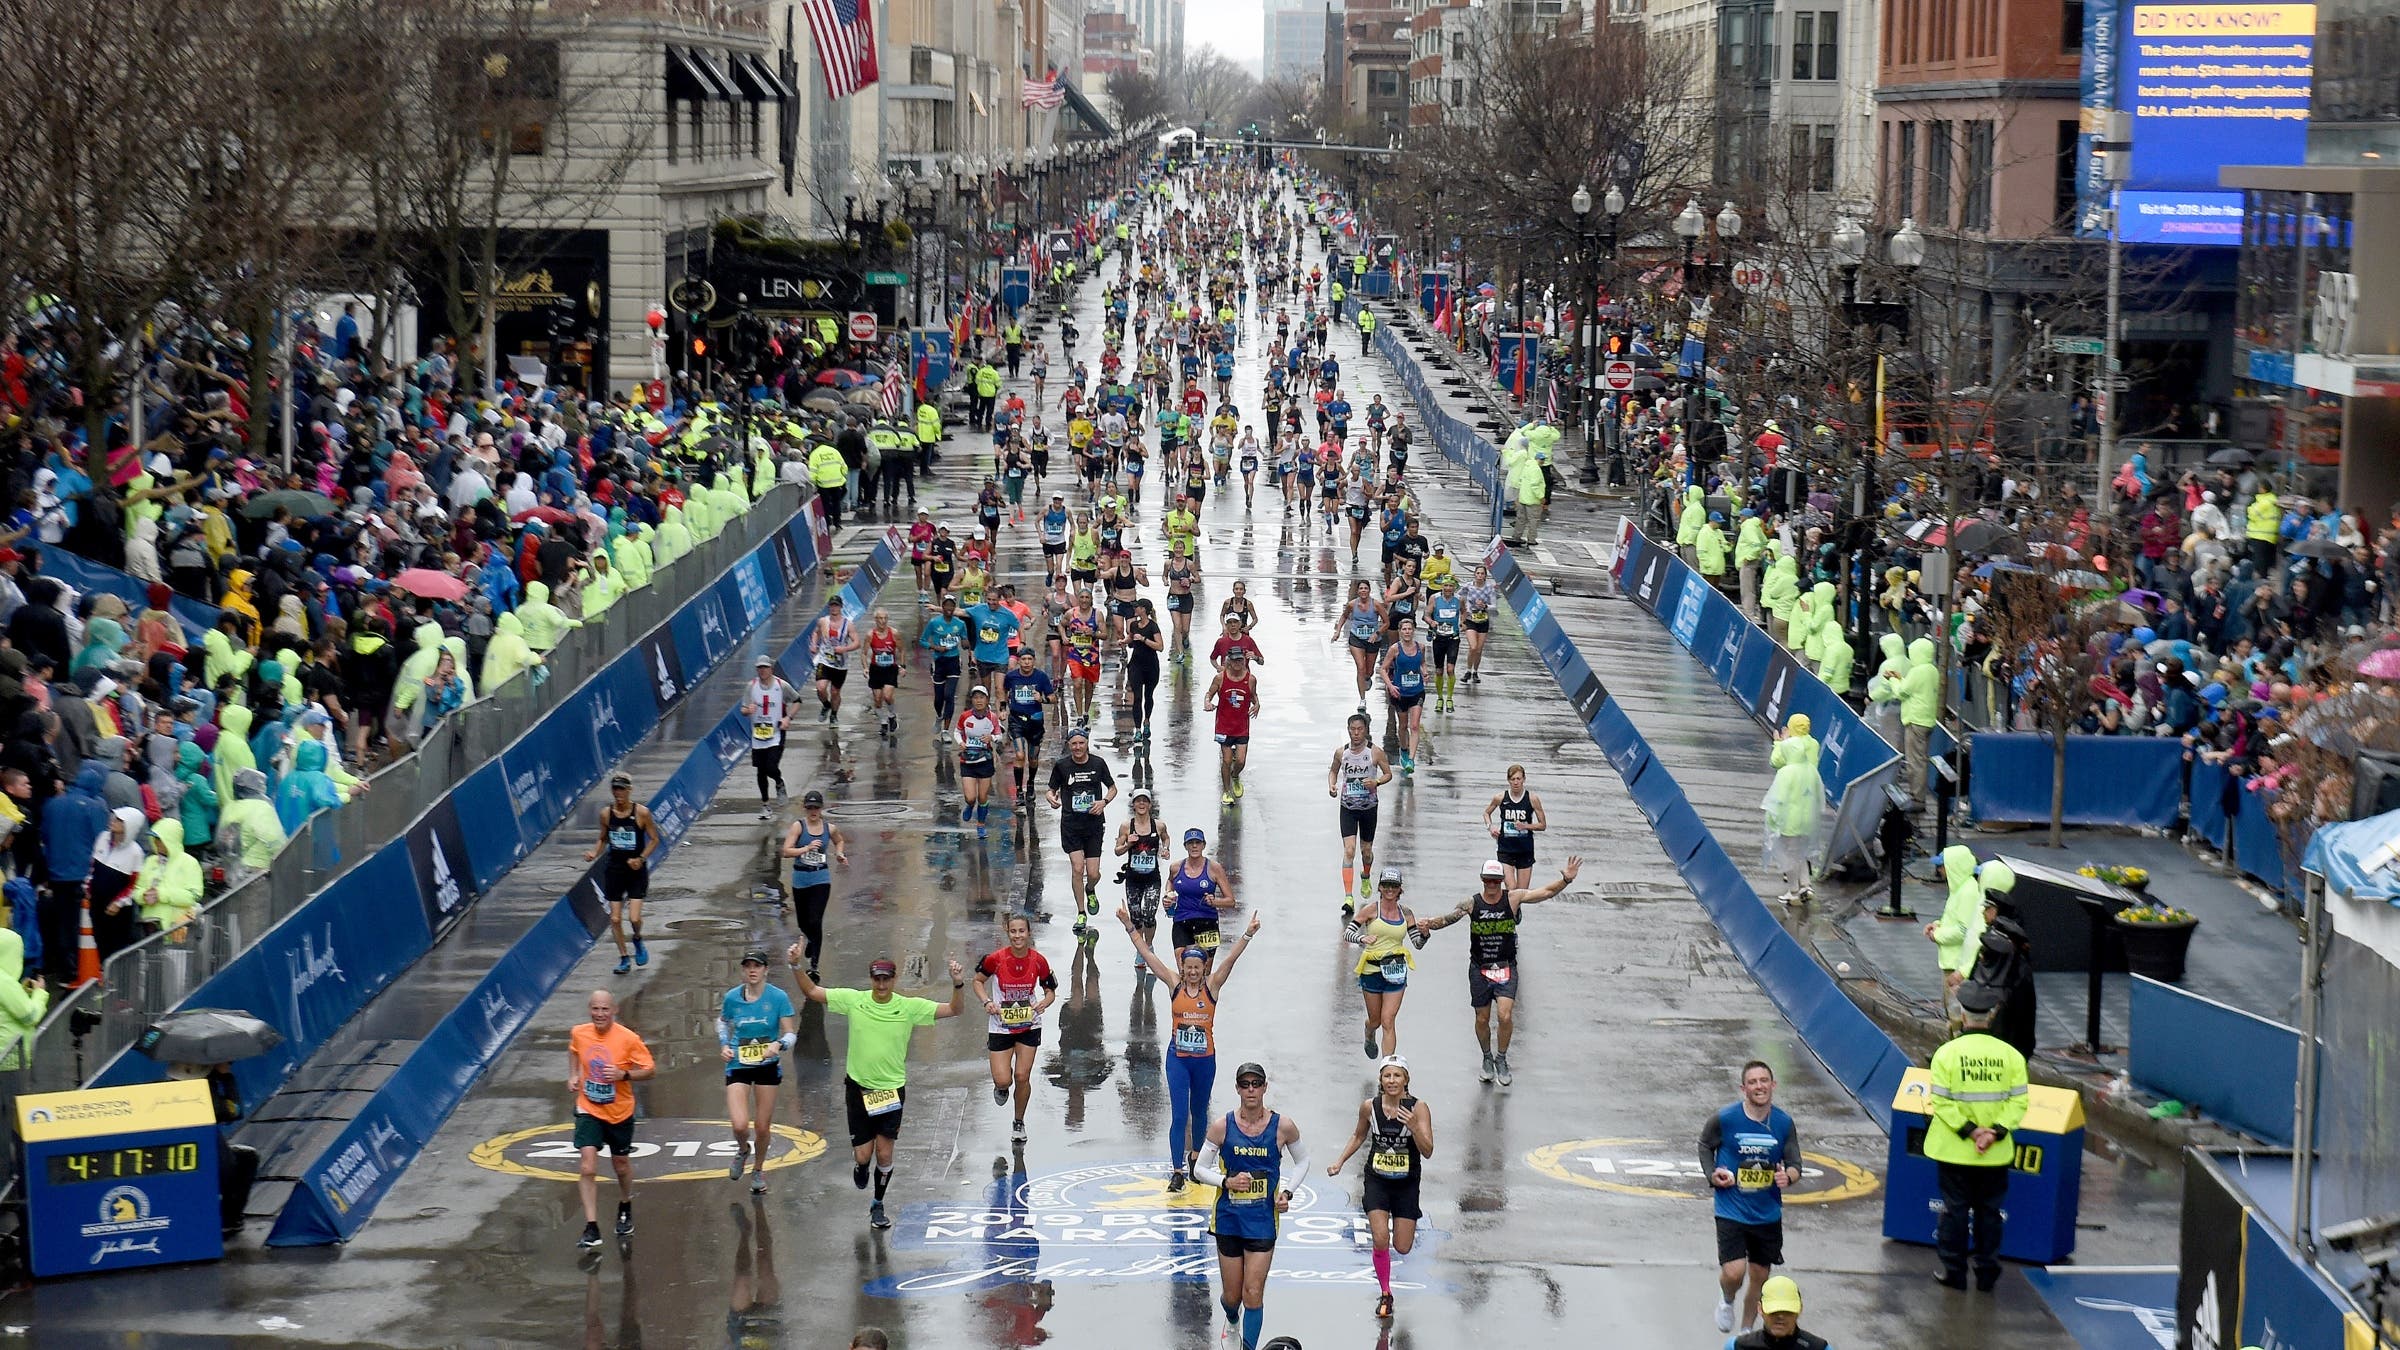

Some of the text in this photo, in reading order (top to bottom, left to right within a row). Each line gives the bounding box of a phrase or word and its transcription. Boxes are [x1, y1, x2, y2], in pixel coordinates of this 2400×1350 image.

[2137, 12, 2281, 28] DID YOU KNOW?
[2094, 16, 2110, 96] MARATHON
[2088, 156, 2103, 190] 2019
[761, 277, 834, 299] LENOX
[1505, 809, 1527, 820] RATS
[1180, 1031, 1205, 1043] 19123
[1960, 1056, 2004, 1068] Boston
[1961, 1068, 2003, 1082] Police
[55, 1100, 131, 1114] 2019 BOSTON
[56, 1108, 133, 1121] MARATHON
[526, 1140, 765, 1158] 2019
[928, 1211, 1084, 1226] 2019
[896, 1253, 1112, 1291] John
